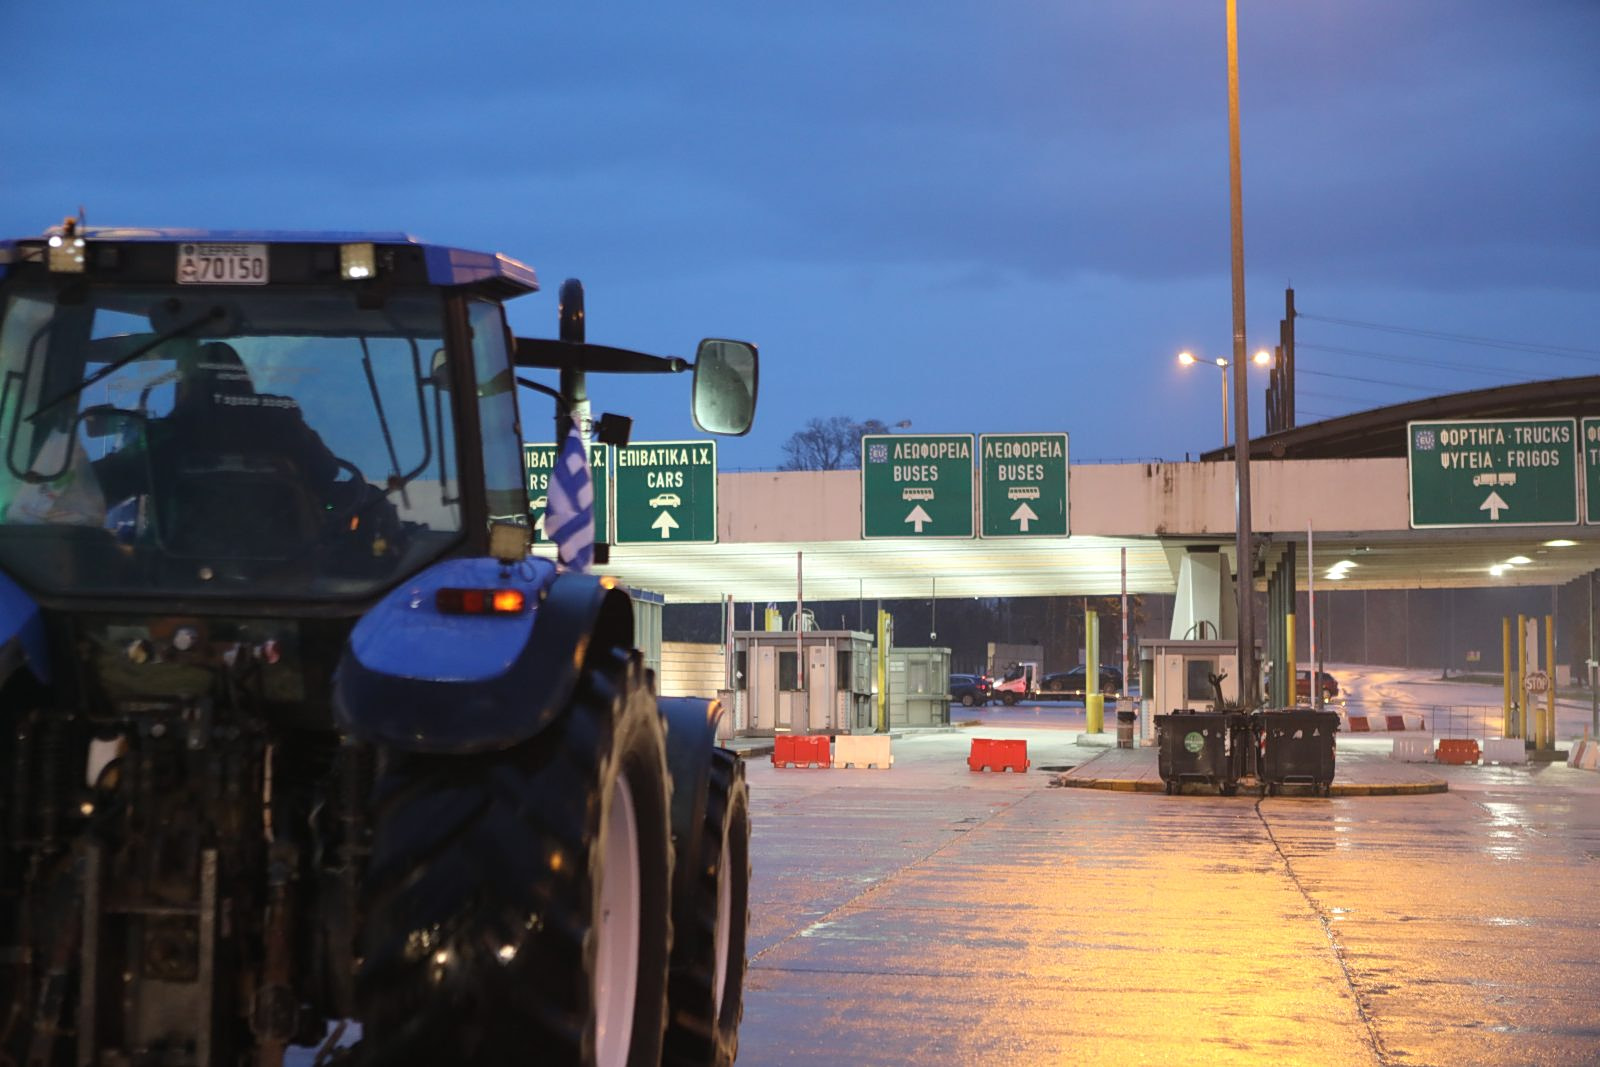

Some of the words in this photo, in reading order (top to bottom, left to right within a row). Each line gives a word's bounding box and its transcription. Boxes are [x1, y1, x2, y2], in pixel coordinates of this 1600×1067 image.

[199, 257, 263, 279] 70150
[1440, 428, 1504, 446] ΦΟΡΤΗΓΑ
[1514, 427, 1570, 445] TRUCKS
[619, 448, 689, 467] ΕΠΙΒΑΤΙΚΑ
[893, 442, 970, 460] ΛΕΩΦΟΡΕΙΑ
[984, 441, 1062, 459] ΛΕΩΦΟΡΕΙΑ
[1440, 451, 1493, 469] ΨΥΓΕΙΑ
[1507, 450, 1560, 468] FRIGOS
[647, 472, 684, 488] CARS
[893, 465, 938, 481] BUSES
[999, 464, 1044, 480] BUSES
[1526, 678, 1547, 690] STOP
